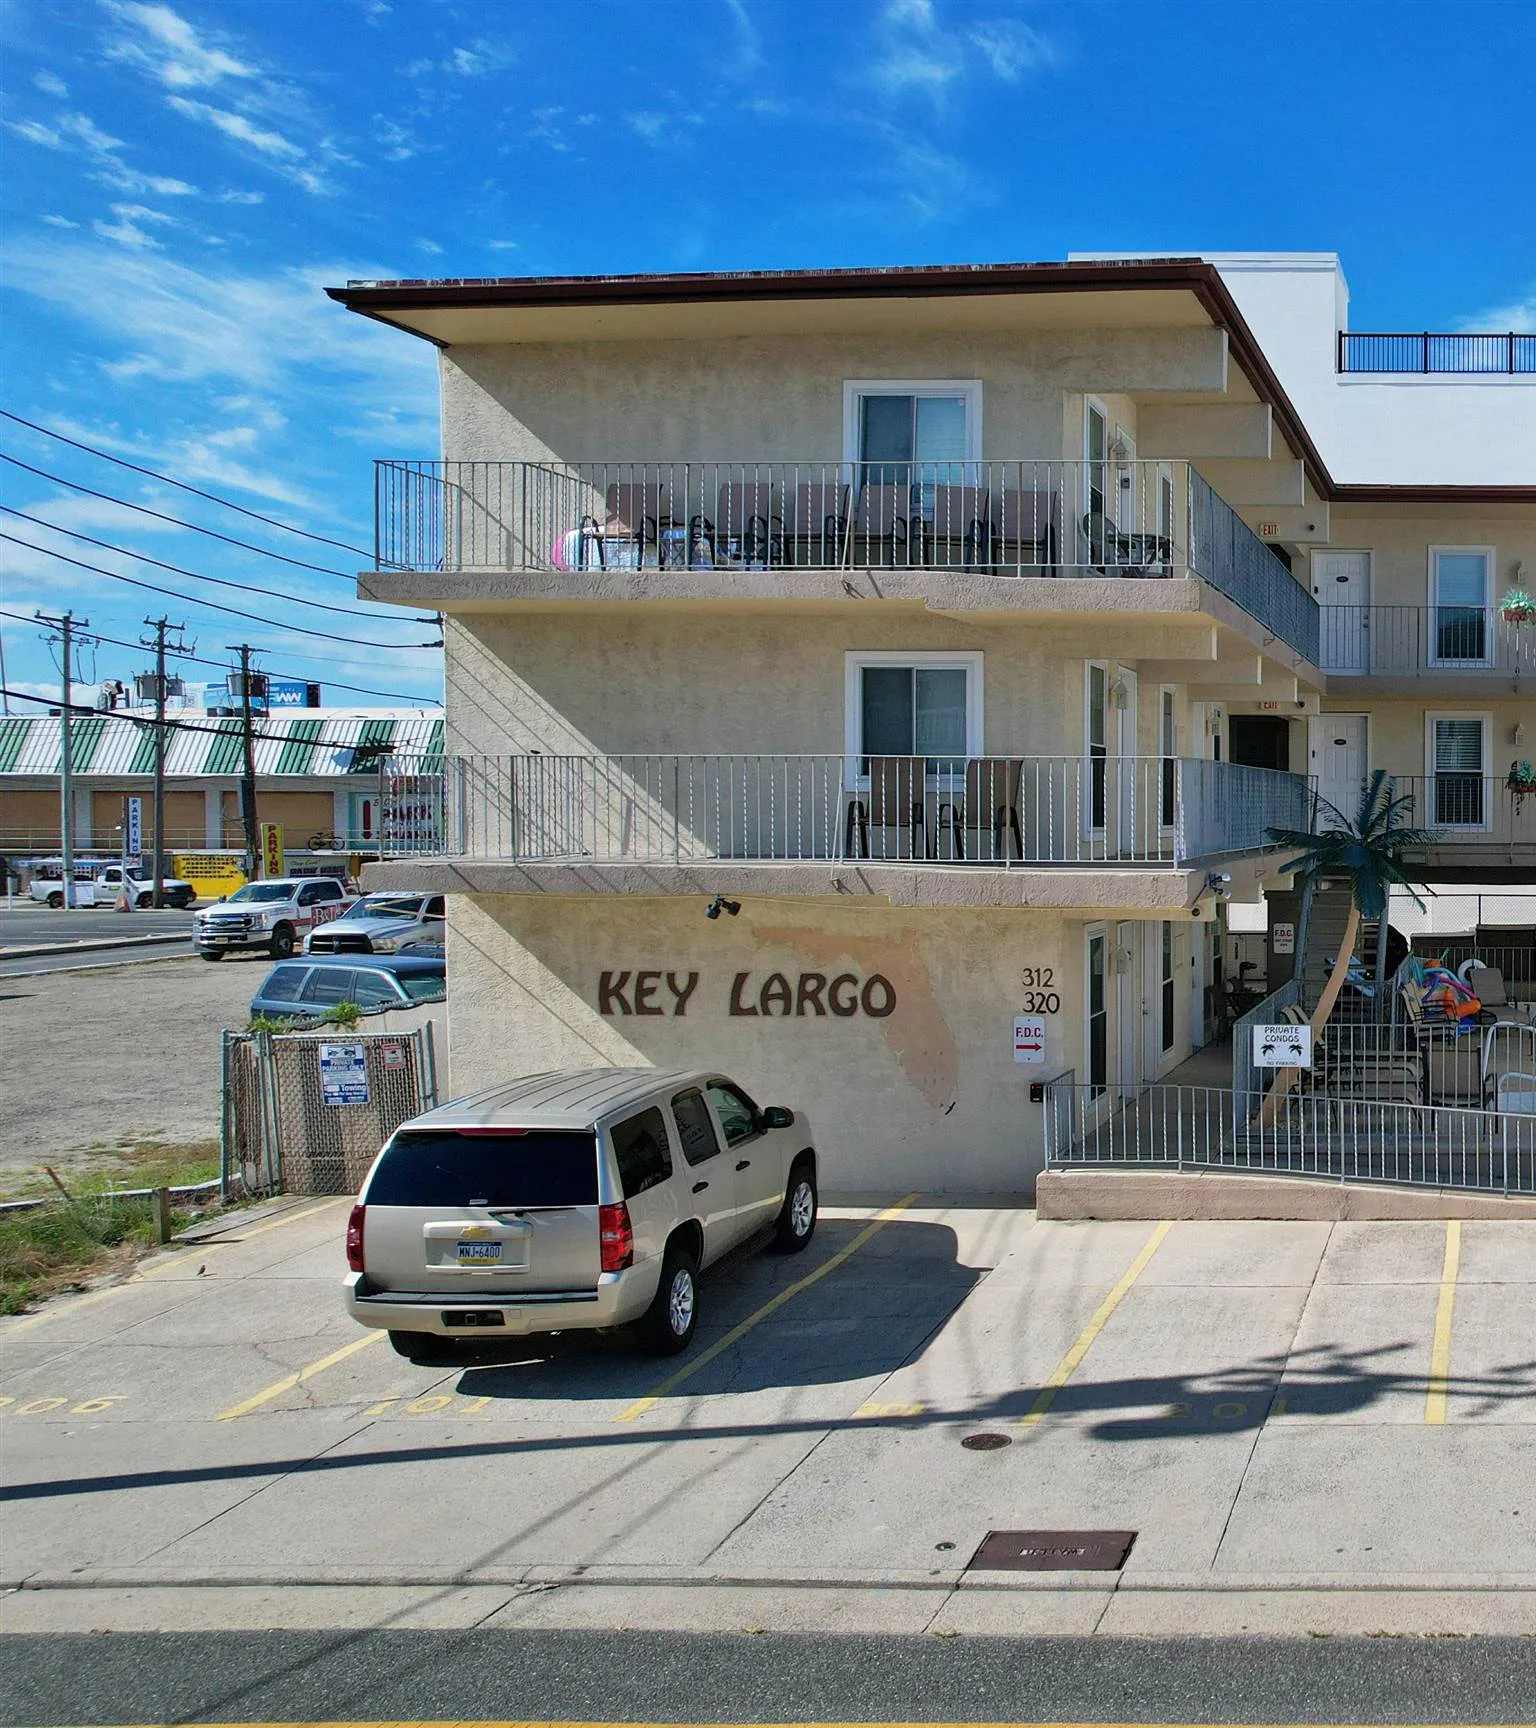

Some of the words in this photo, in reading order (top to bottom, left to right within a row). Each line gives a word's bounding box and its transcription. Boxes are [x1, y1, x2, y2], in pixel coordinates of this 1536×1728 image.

[1263, 524, 1277, 536] EXIT
[131, 799, 139, 852] PARKING
[268, 824, 279, 875] PARKING
[1022, 967, 1055, 987] 312
[599, 970, 699, 1016] KEY
[729, 971, 897, 1017] LARGO
[1023, 991, 1061, 1014] 320
[1015, 1026, 1044, 1038] F.D.C.
[1264, 1026, 1300, 1034] PRIVATE
[1264, 1034, 1300, 1043] CONDOS
[341, 1084, 367, 1092] Towing
[0, 1395, 129, 1416] 06
